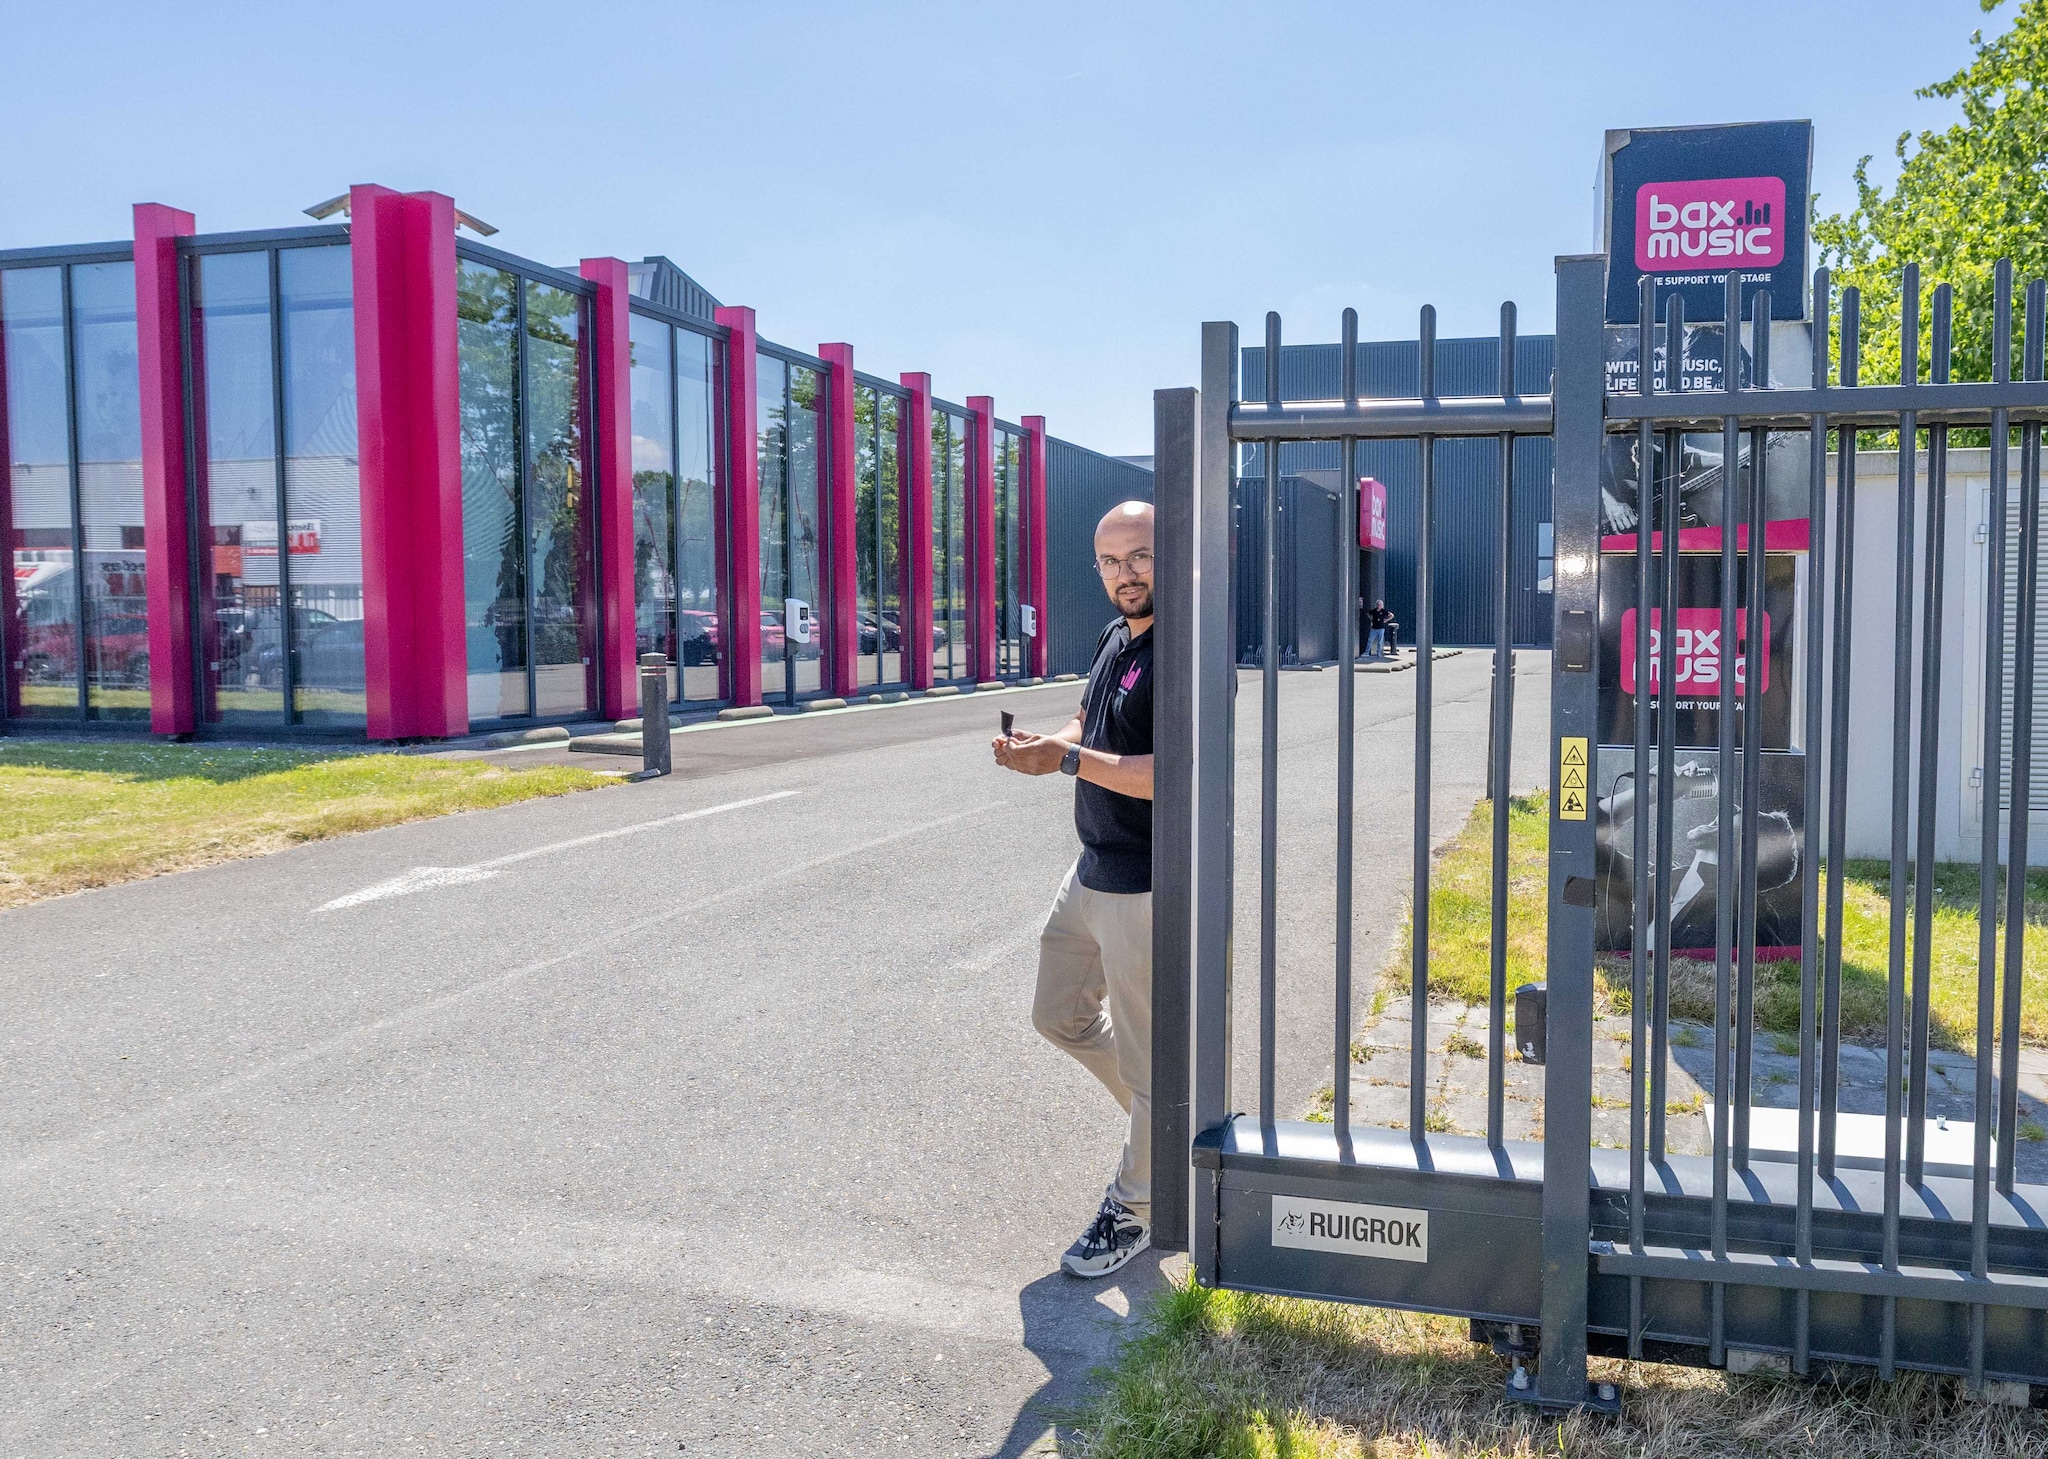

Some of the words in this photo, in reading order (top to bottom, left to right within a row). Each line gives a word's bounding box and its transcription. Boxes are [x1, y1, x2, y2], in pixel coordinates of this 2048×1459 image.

[1650, 194, 1735, 230] bax
[1647, 227, 1771, 258] music
[1665, 275, 1710, 285] SUPPORT
[1740, 273, 1771, 283] STAGE
[1606, 378, 1637, 391] LIFE
[1310, 1212, 1421, 1248] RUIGROK
